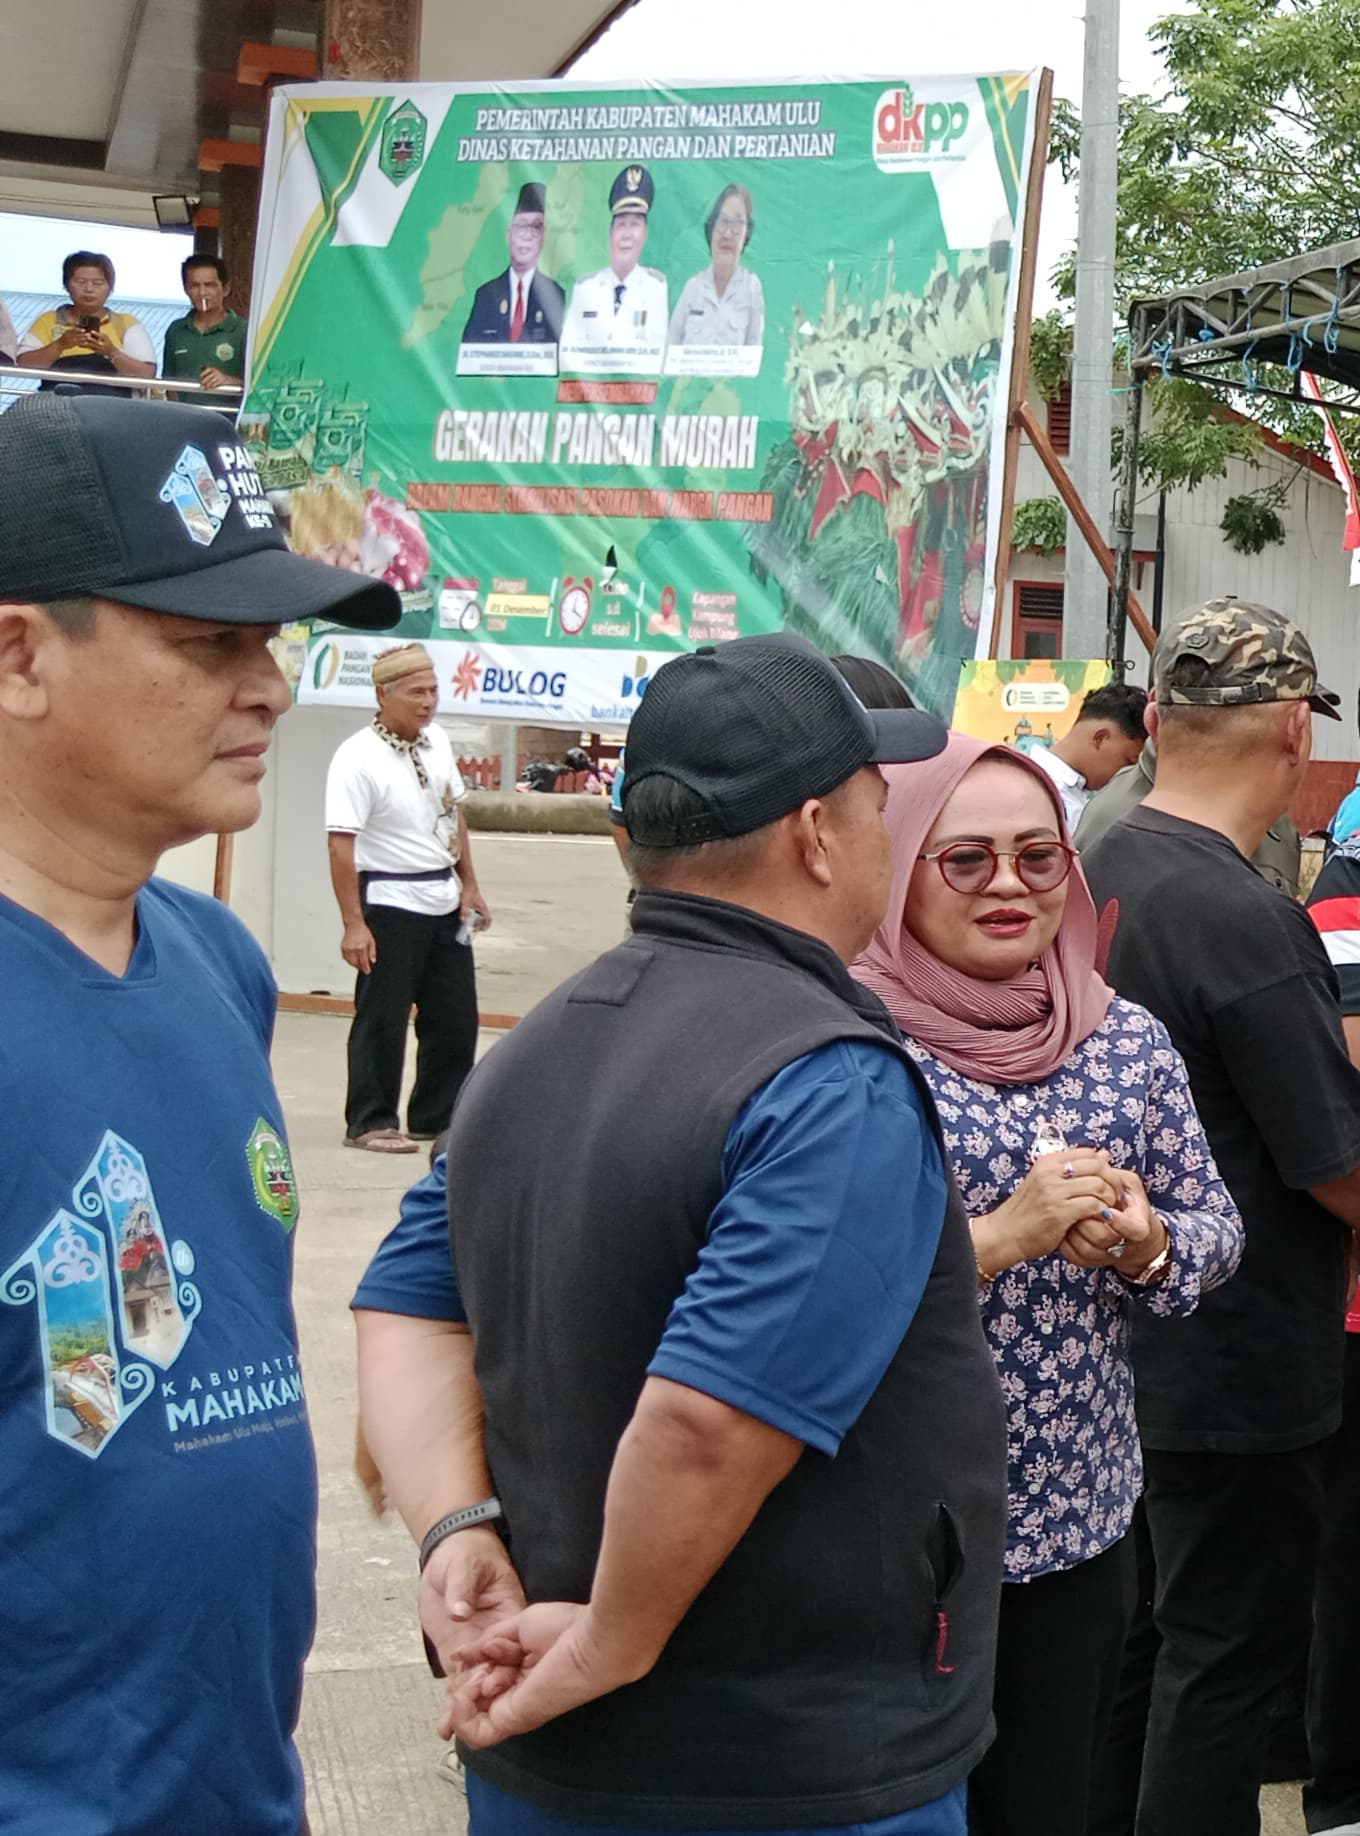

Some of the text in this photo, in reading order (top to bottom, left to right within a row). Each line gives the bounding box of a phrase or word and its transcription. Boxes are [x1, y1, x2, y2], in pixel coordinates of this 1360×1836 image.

[475, 101, 821, 131] PEMERINTAH KABUPATEN MAHAKAM ULU
[878, 91, 970, 152] dkpp
[457, 132, 836, 161] DINAS KETAHANAN PANGAN DAN PERTANIAN
[433, 410, 759, 470] GERAKAN PANGAN MURAH
[716, 492, 774, 523] PANGAN
[503, 602, 548, 615] Desember
[481, 667, 568, 698] BULOG
